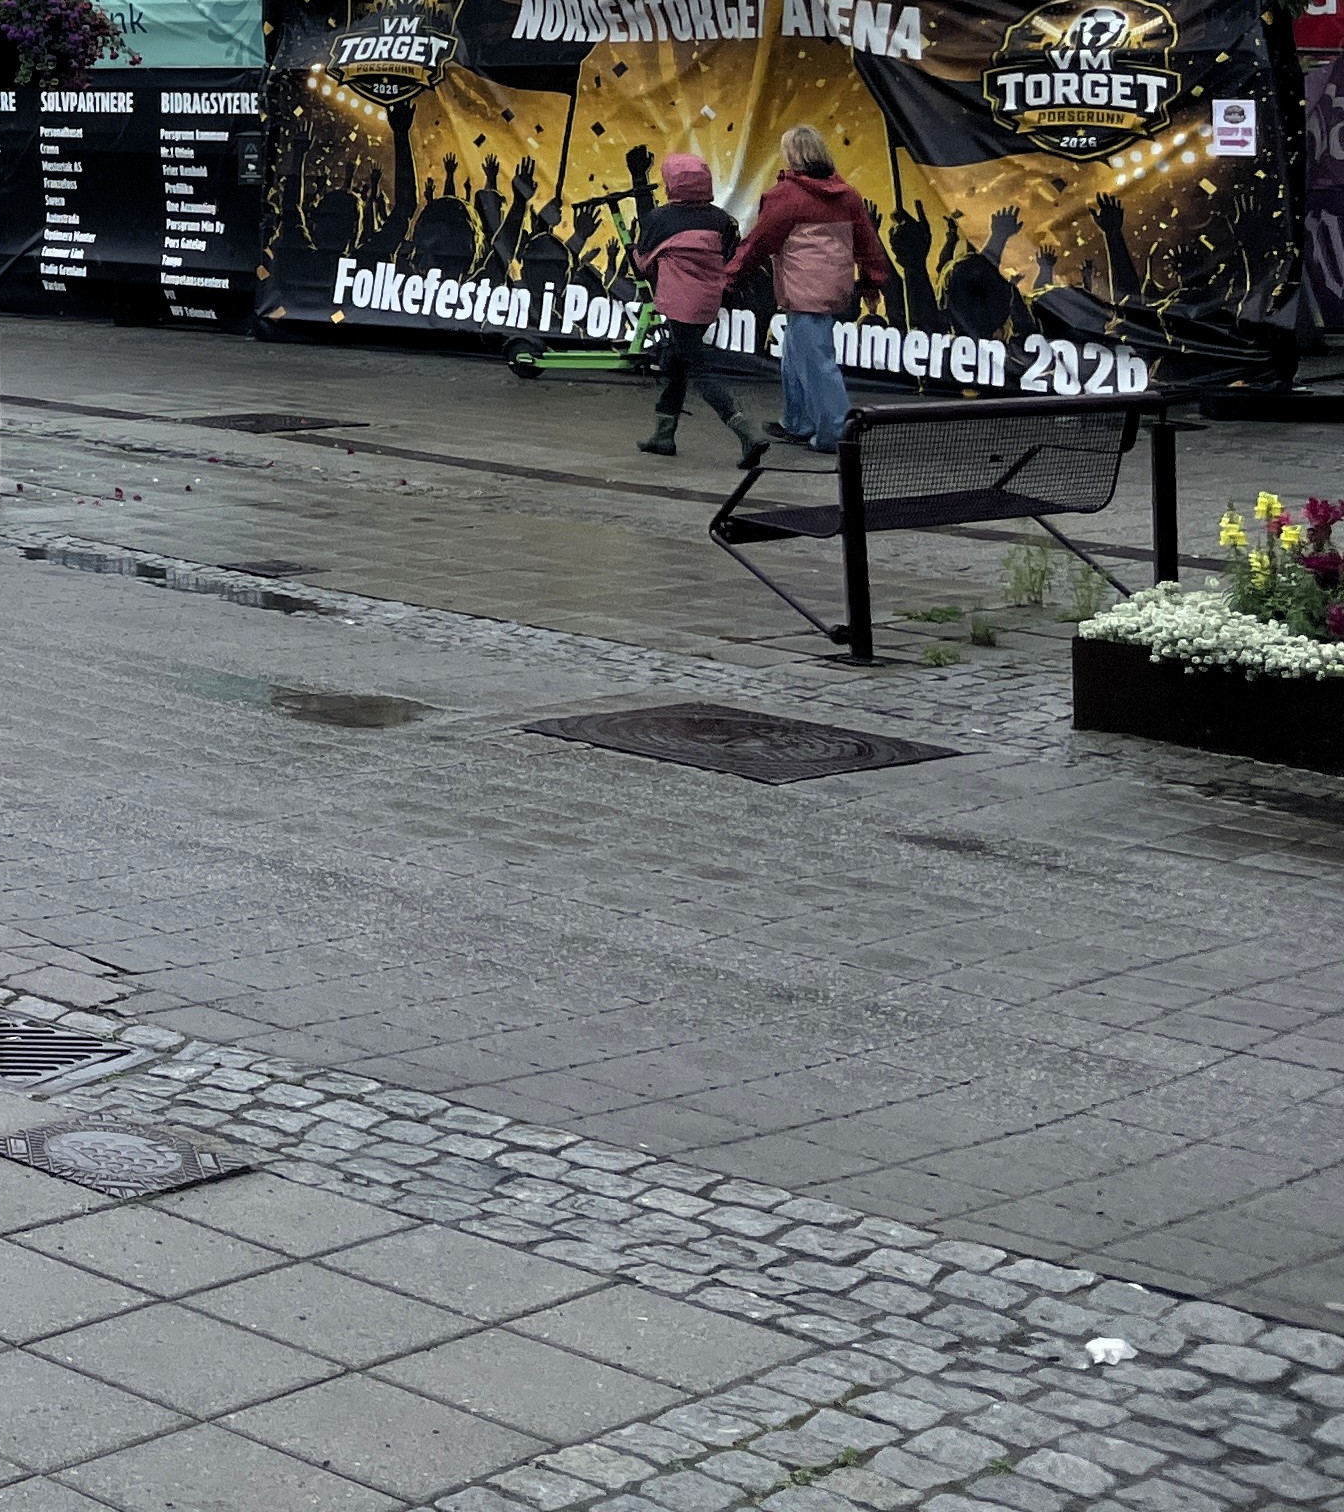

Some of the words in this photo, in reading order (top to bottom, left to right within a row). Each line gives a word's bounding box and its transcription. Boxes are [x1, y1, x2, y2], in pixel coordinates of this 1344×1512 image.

[380, 16, 420, 35] VM
[340, 35, 449, 65] TORGET
[1051, 50, 1111, 71] VM
[373, 83, 400, 95] 2026
[997, 73, 1167, 113] TORGET
[40, 91, 134, 113] SØLVPARTNERE
[160, 92, 259, 115] BIDRAGSYTERE
[1038, 111, 1125, 125] PORSGRUNN
[1060, 137, 1097, 149] 2026
[333, 257, 531, 330] Folkefesten
[541, 283, 555, 332] i
